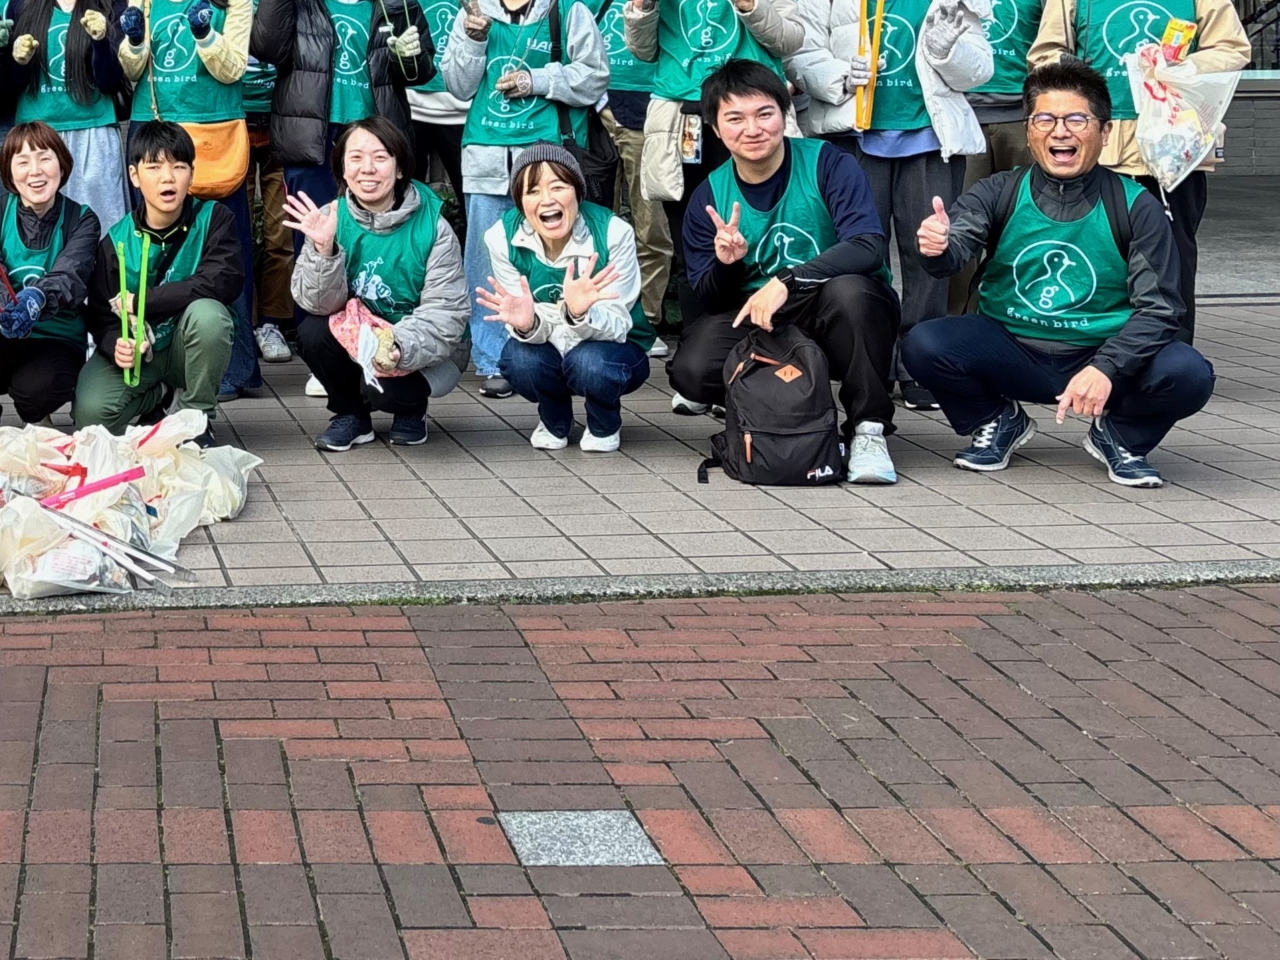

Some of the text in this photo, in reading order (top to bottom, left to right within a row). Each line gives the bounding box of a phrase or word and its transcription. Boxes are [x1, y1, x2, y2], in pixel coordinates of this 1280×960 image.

[526, 37, 553, 54] UA
[609, 57, 634, 66] bird
[1106, 67, 1128, 77] gre
[174, 74, 197, 82] bird
[886, 78, 913, 87] bird
[509, 121, 535, 129] bird
[1006, 307, 1090, 328] green bird
[806, 464, 834, 482] FILA
